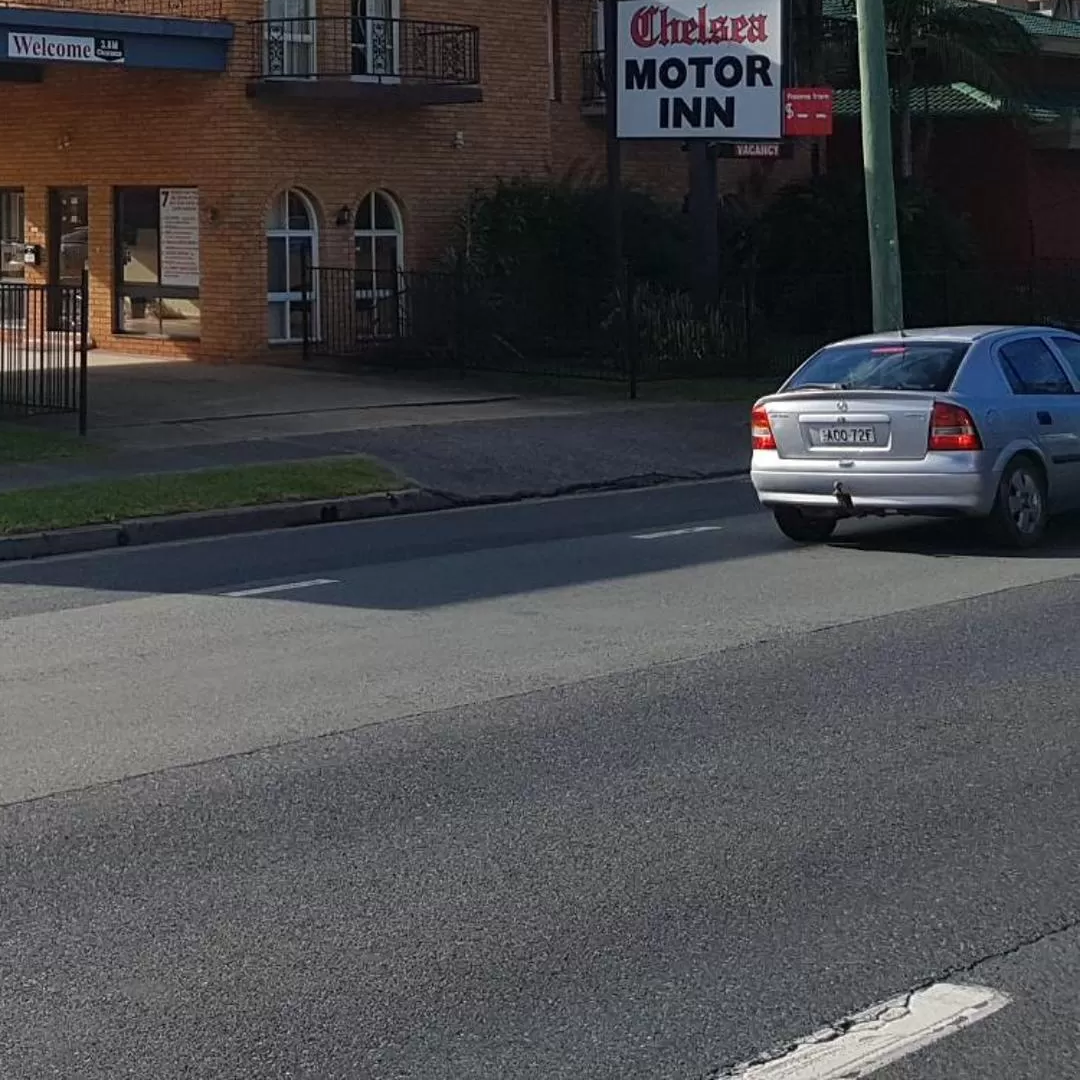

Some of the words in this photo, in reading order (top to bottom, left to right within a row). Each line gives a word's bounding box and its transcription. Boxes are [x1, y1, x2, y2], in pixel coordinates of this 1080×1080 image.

[630, 3, 769, 48] Chelsea
[13, 35, 92, 59] Welcome
[625, 55, 773, 90] MOTOR
[659, 96, 735, 129] INN
[736, 143, 780, 156] VACANCY
